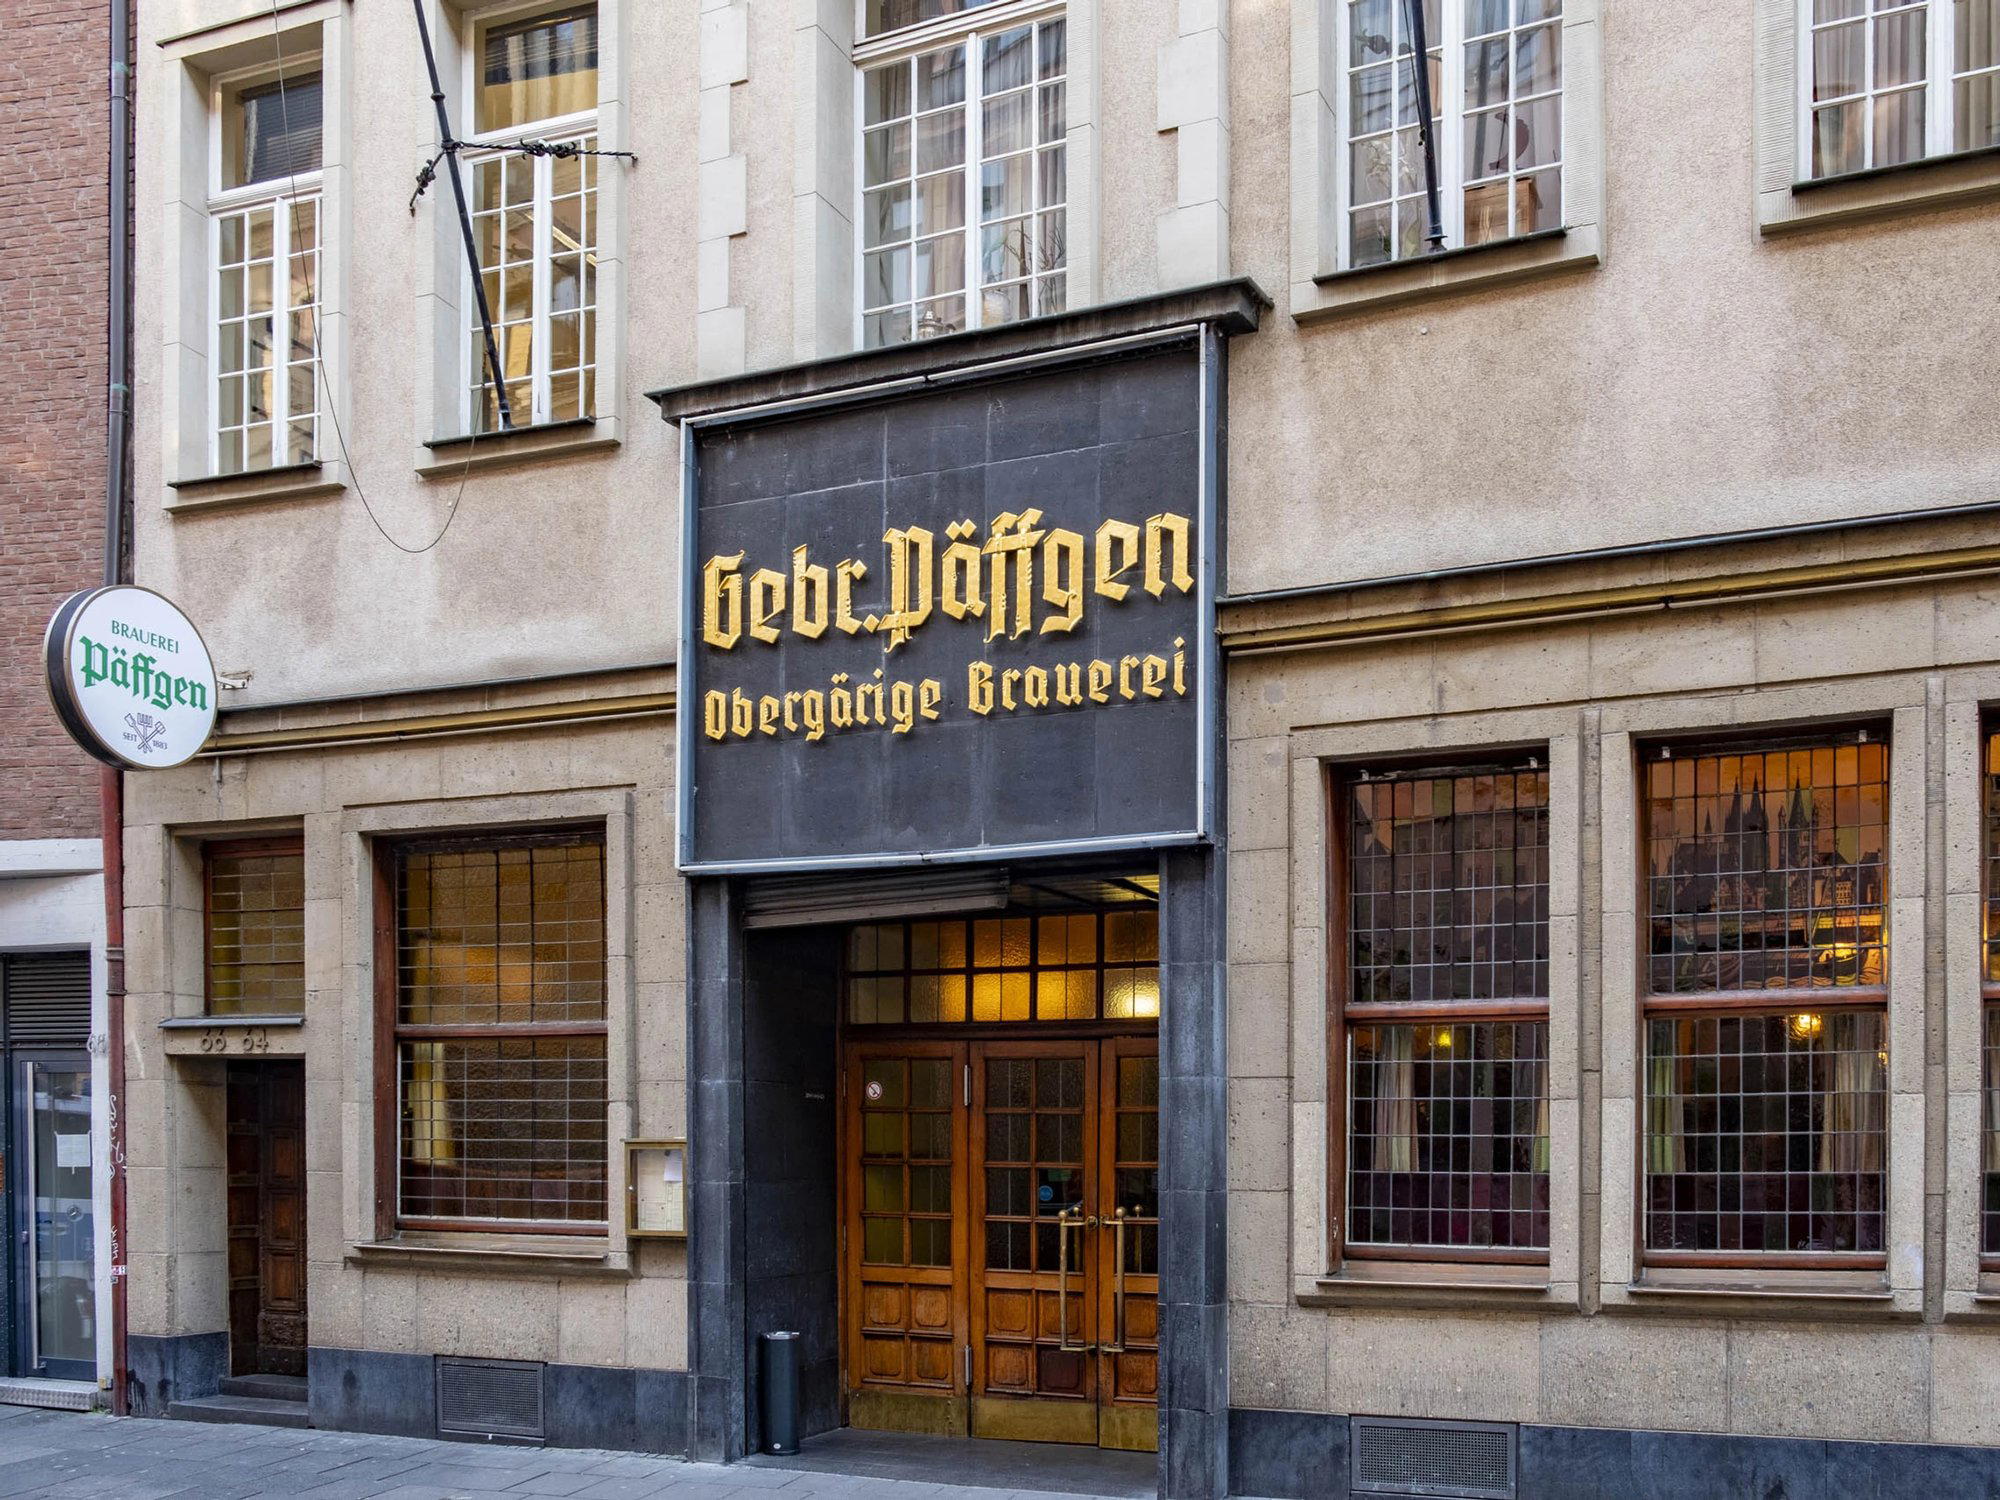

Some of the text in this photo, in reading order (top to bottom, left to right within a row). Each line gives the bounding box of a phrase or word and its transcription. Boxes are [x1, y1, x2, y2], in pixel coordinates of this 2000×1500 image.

[702, 508, 1195, 651] Gebr. Päffgen
[79, 636, 208, 711] Päffgen
[111, 620, 179, 653] BRAUEREI
[704, 637, 1187, 741] Obergärige Brauerei
